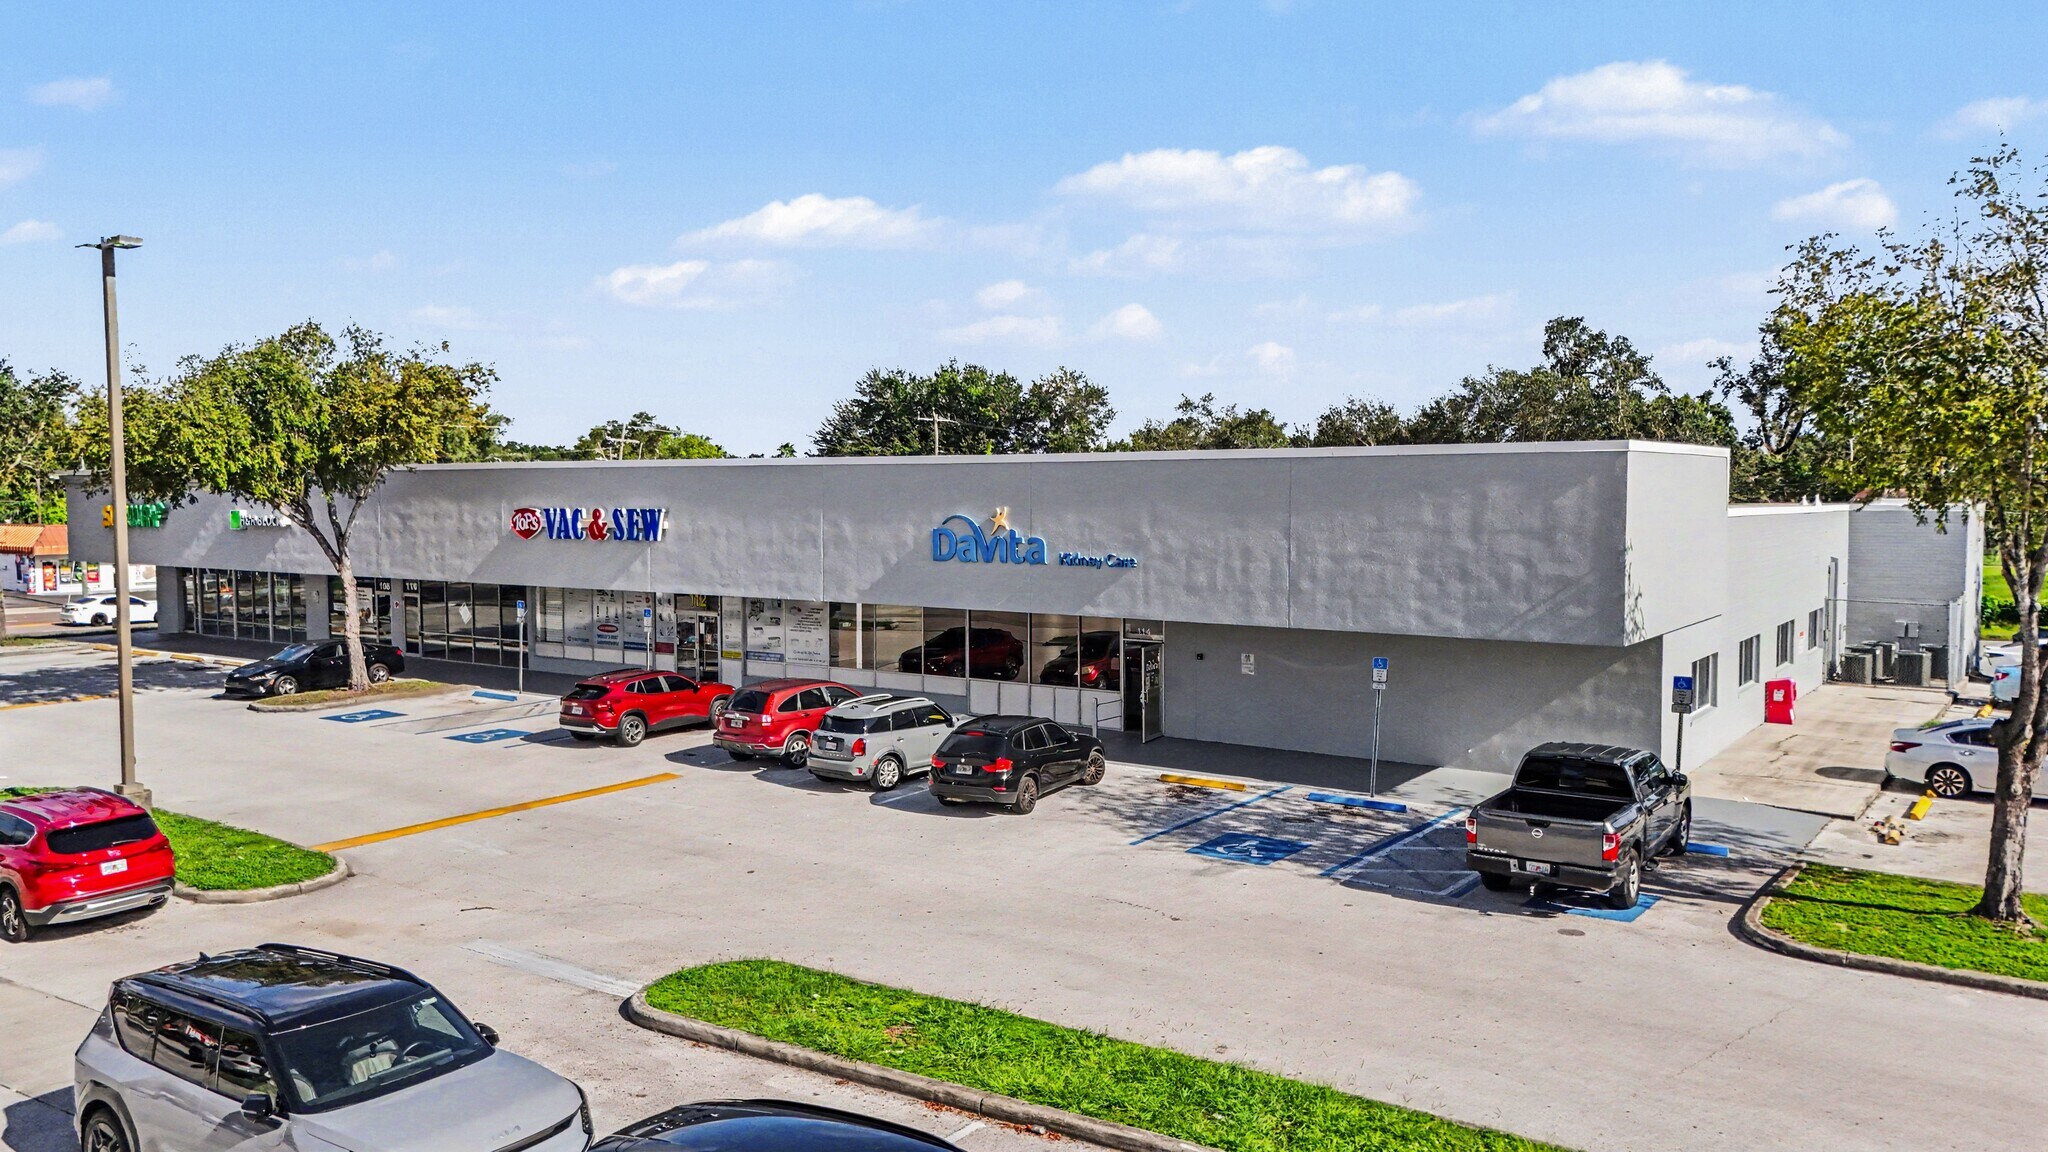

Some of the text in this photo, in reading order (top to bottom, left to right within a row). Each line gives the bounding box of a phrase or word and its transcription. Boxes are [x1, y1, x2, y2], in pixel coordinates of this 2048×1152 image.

[543, 507, 586, 541] VAC
[588, 508, 609, 541] &
[612, 508, 664, 542] SEW
[932, 514, 1138, 569] DaVita Kidney Care
[689, 594, 707, 607] 112
